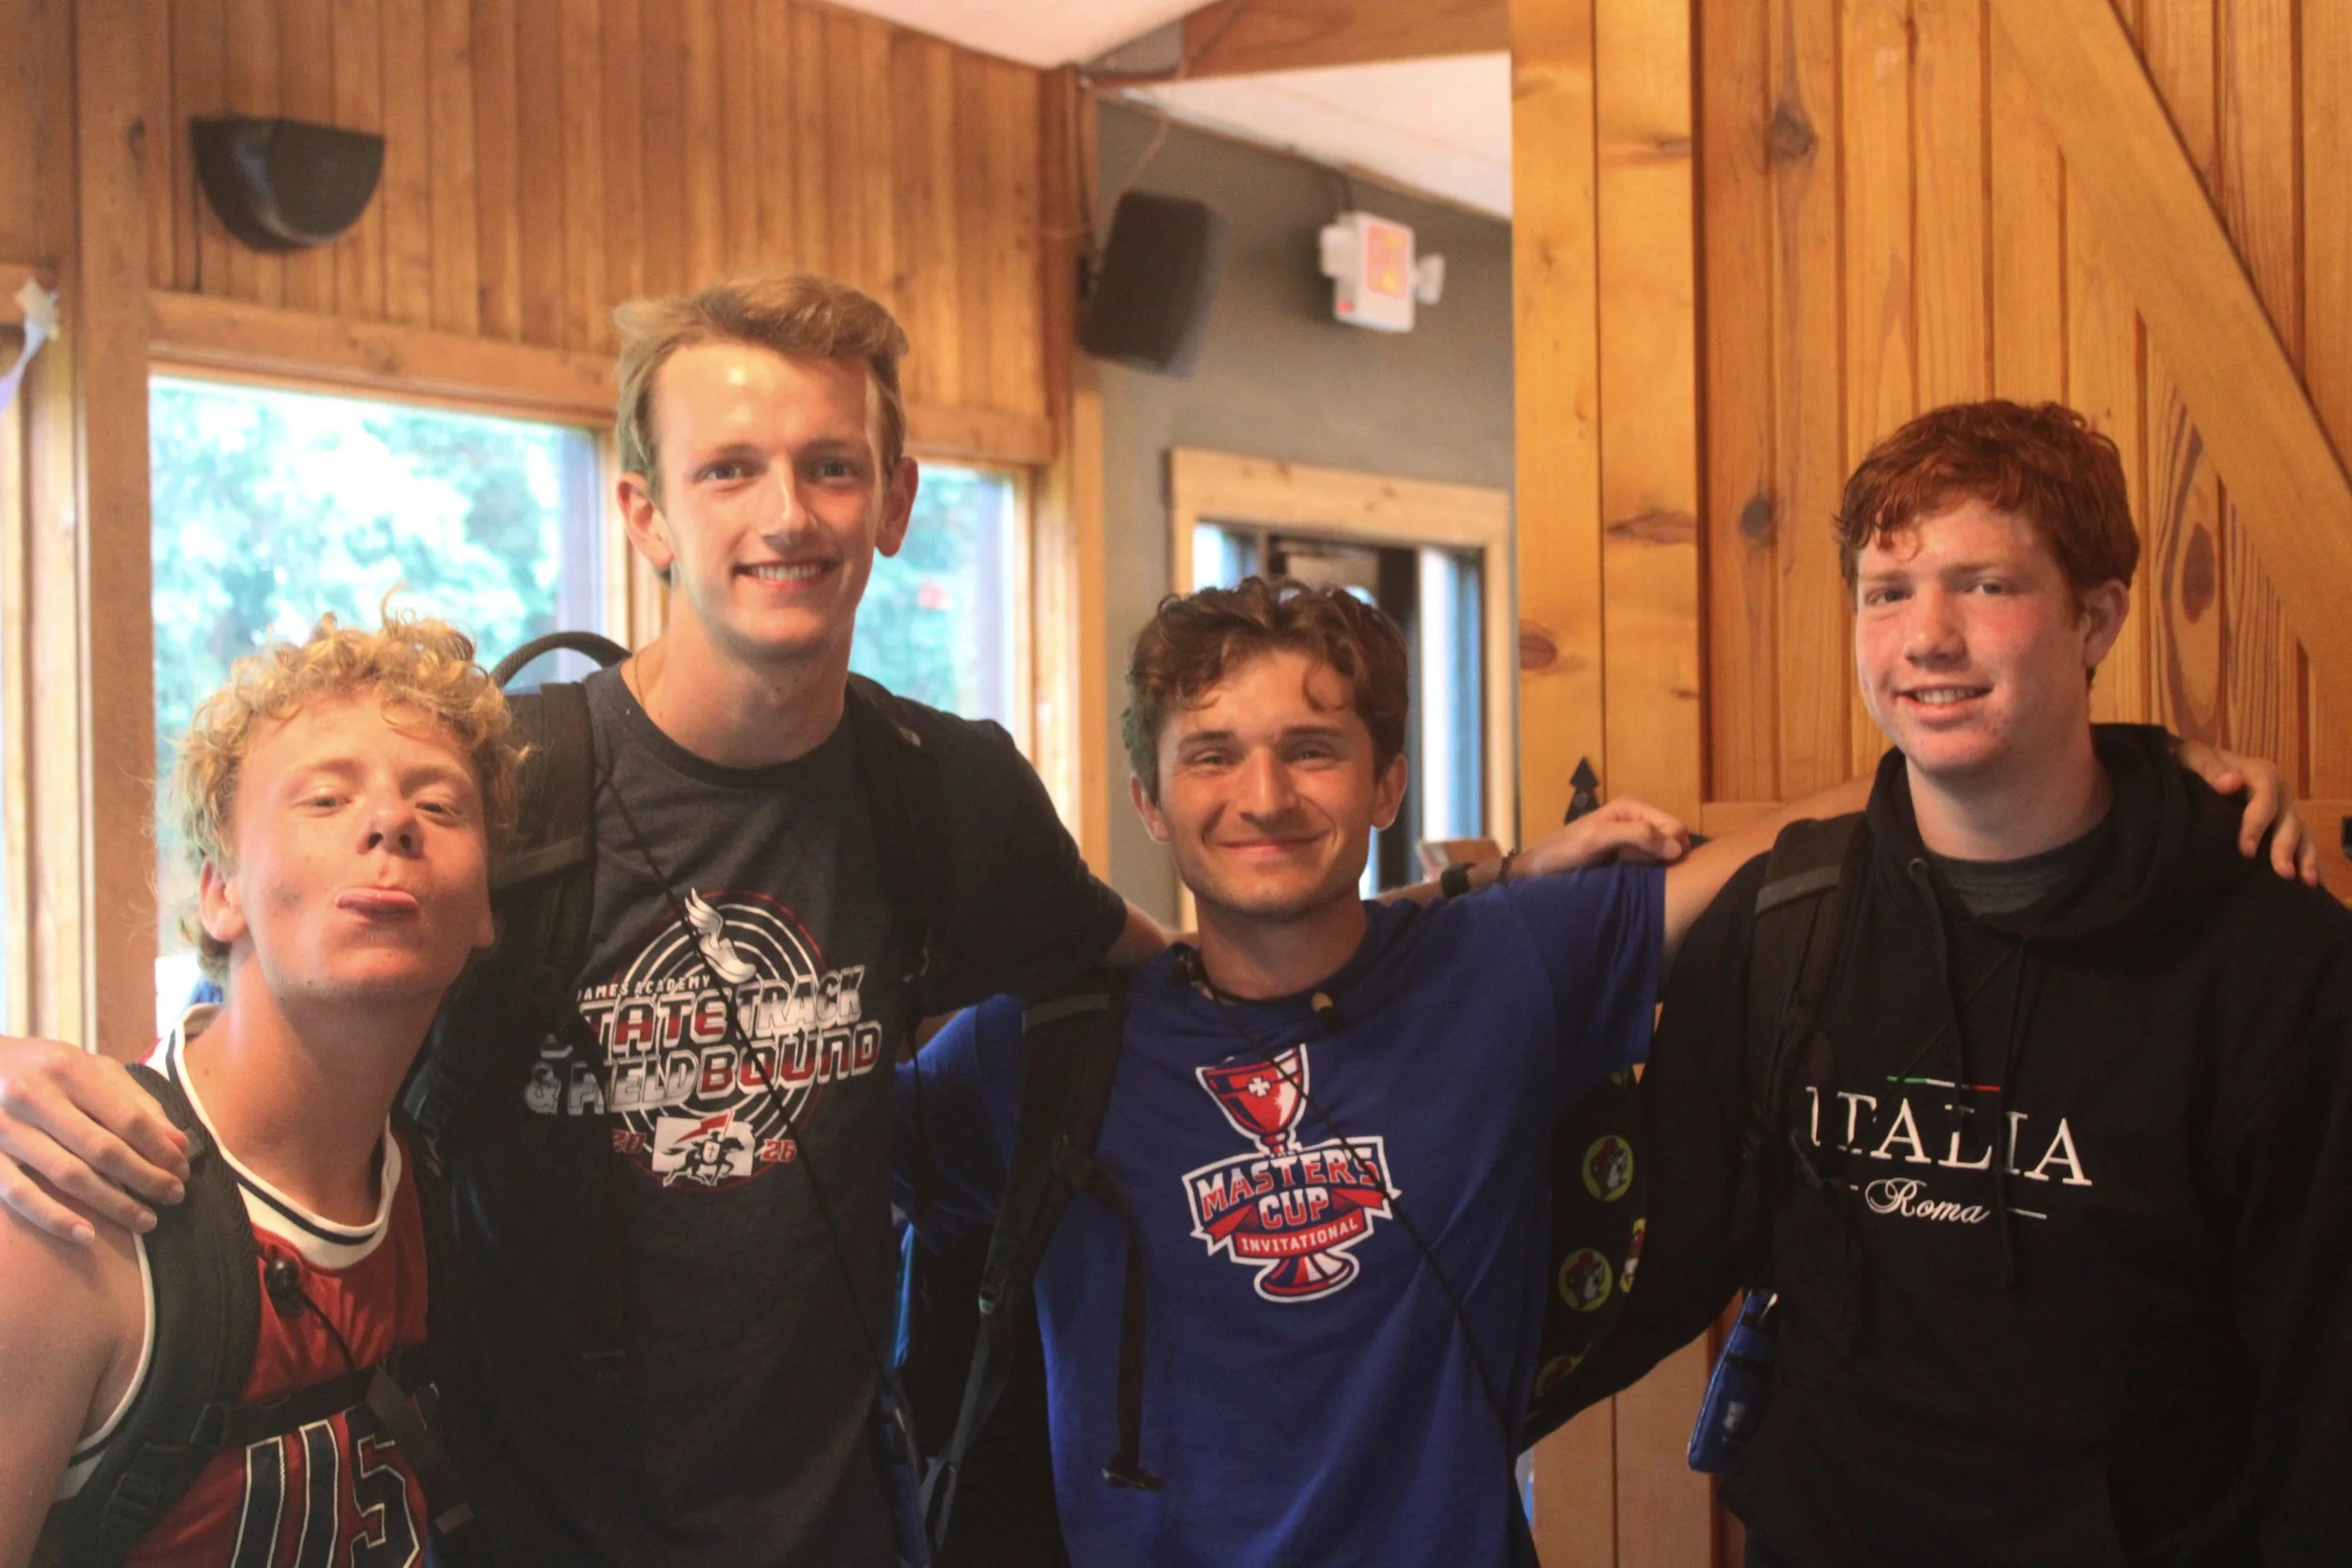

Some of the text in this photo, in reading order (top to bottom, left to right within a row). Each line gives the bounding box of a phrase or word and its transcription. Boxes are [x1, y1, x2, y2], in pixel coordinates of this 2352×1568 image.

[633, 974, 710, 995] ACADEMY
[735, 964, 866, 1041] TRACK
[695, 1021, 882, 1101] BOUND
[1805, 1085, 2092, 1186] ITALIA
[1258, 1186, 1329, 1229] CUP
[1865, 1178, 1992, 1224] Roma
[1240, 1217, 1359, 1254] INVITATIONAL
